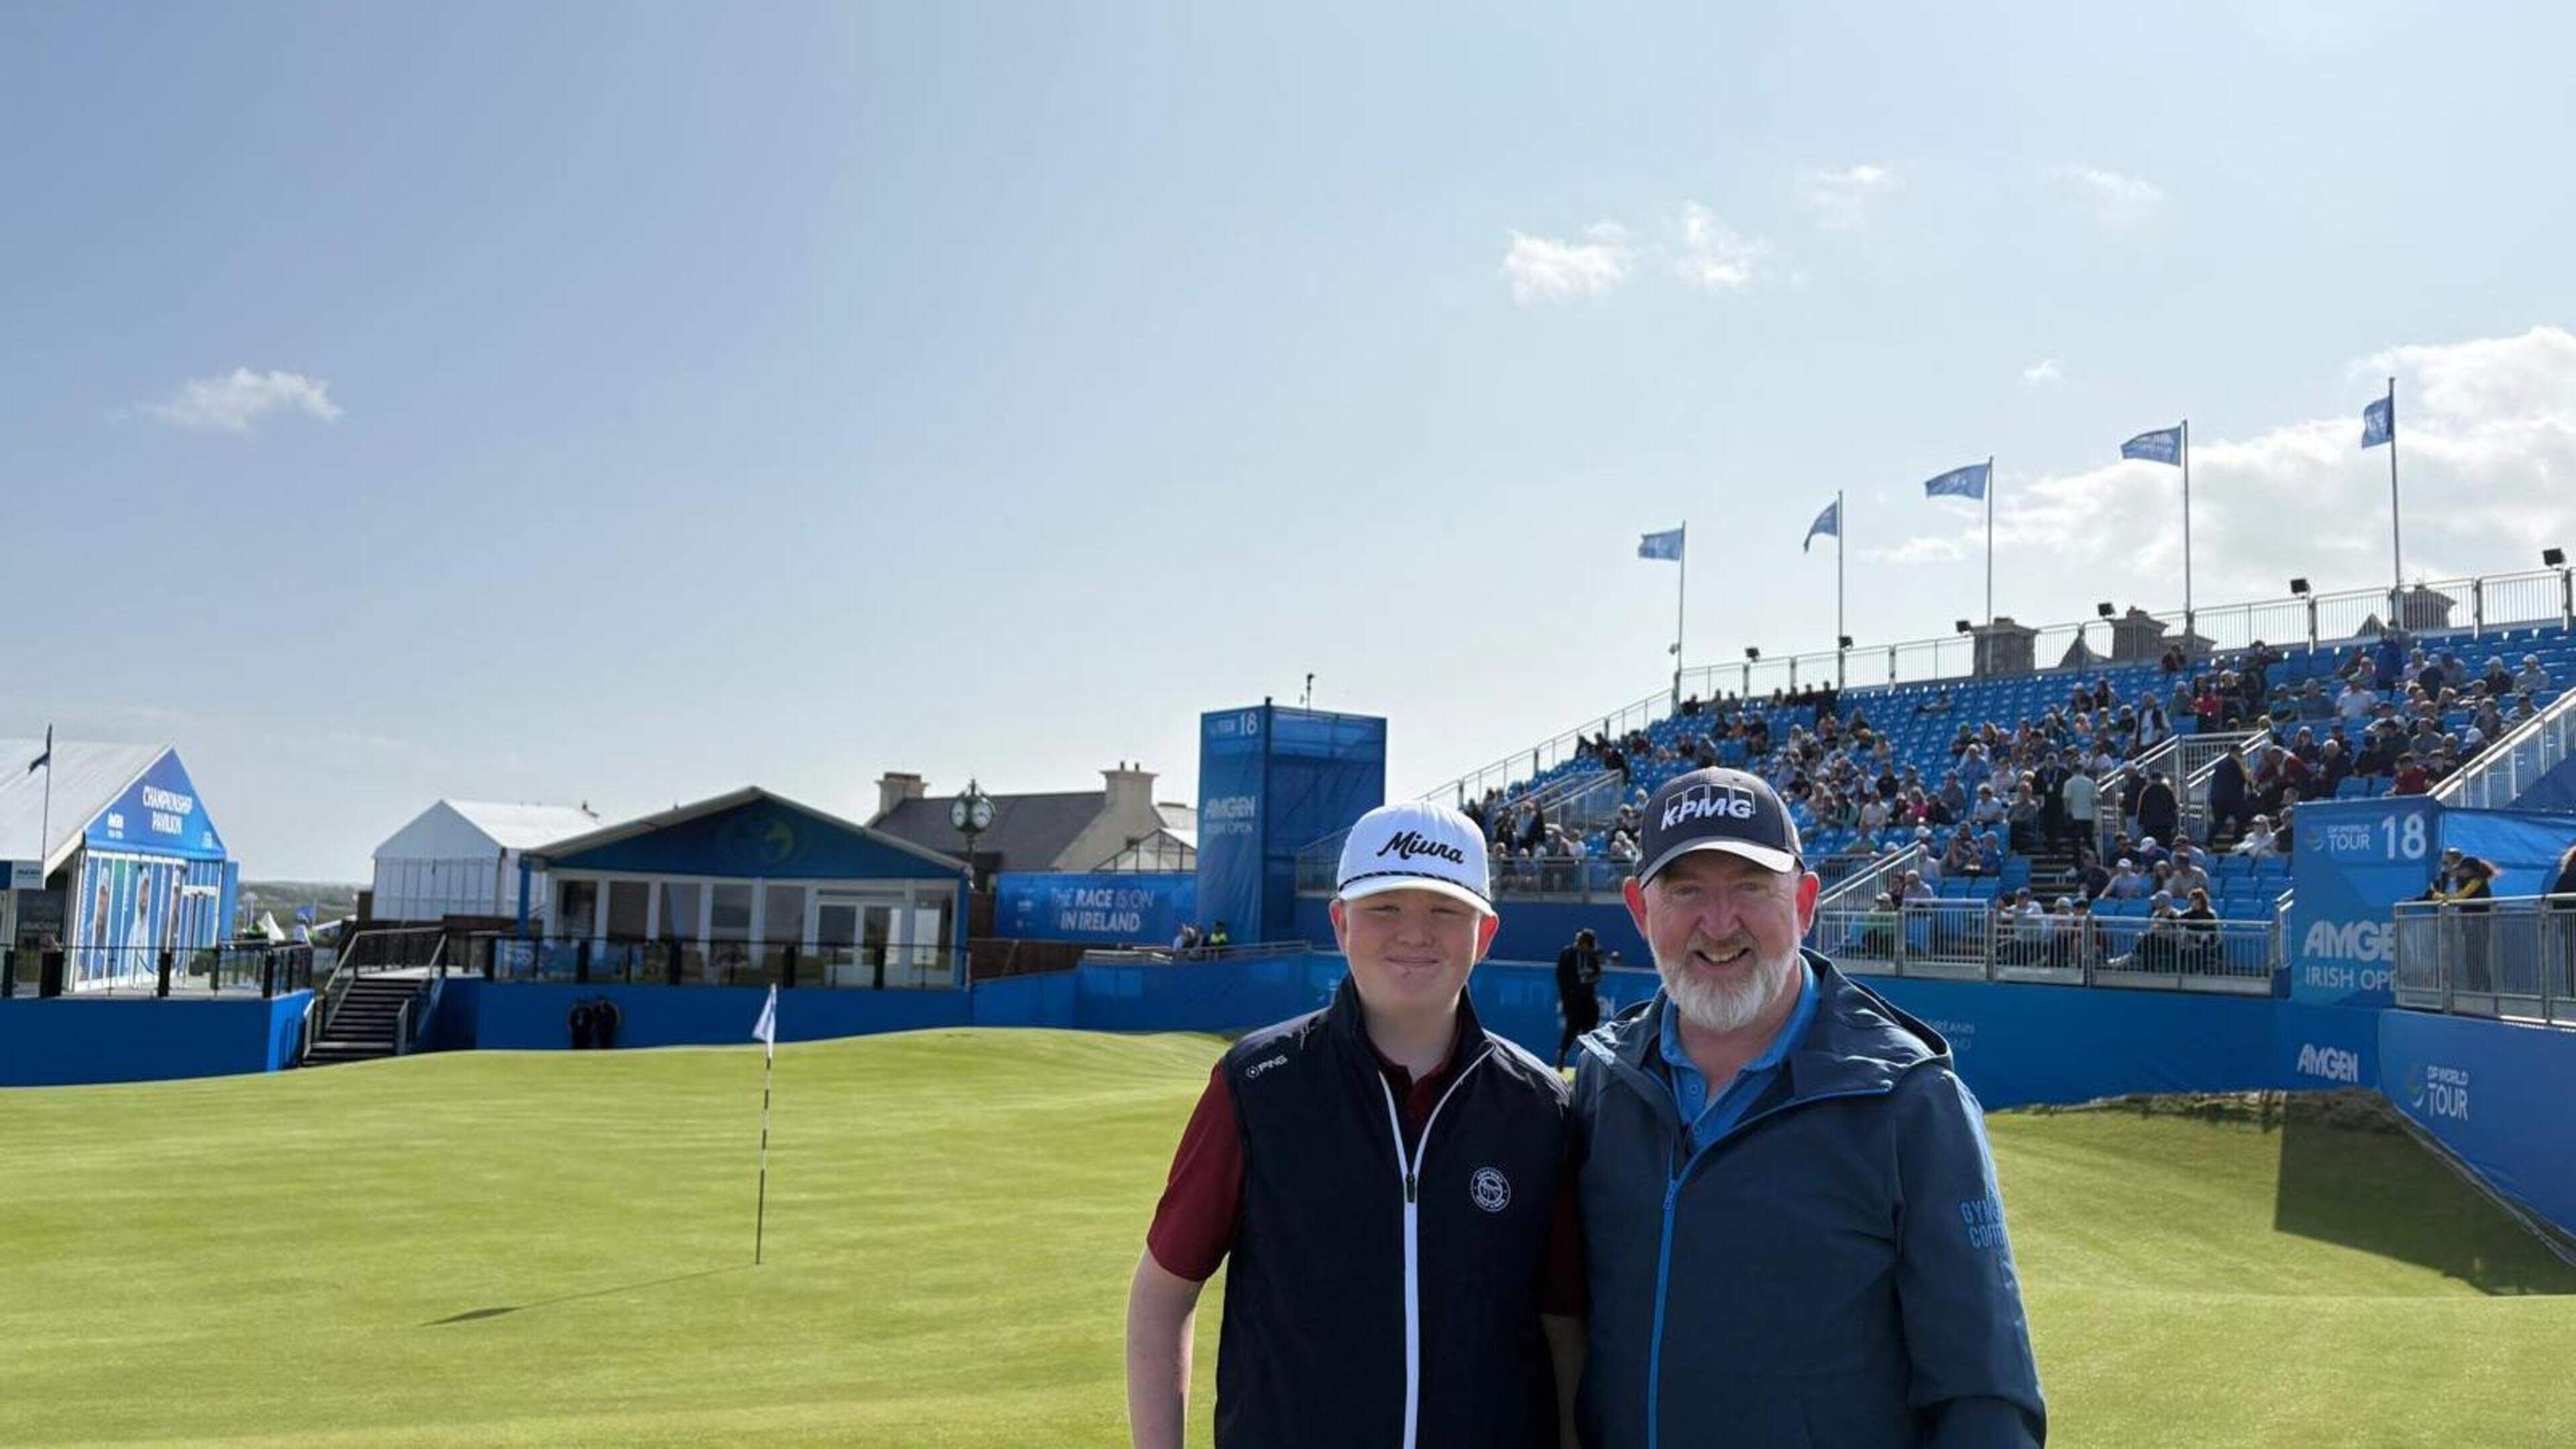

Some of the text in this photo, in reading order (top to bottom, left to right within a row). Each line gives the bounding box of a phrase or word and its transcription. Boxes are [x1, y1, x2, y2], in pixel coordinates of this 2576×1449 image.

[1239, 712, 1258, 737] 18
[143, 785, 193, 815] CHAMPIONSHIP
[1203, 795, 1256, 820] AMGEN
[152, 811, 182, 835] PAVILION
[1661, 798, 1752, 831] KPMG
[1377, 831, 1464, 864] Miura
[2328, 833, 2371, 852] TOUR
[2383, 813, 2427, 859] 18
[1075, 889, 1114, 907] RACE
[1061, 912, 1141, 932] IN IRELAND
[2302, 920, 2396, 961] AMGE
[2306, 966, 2354, 988] IRISH
[1258, 1055, 1288, 1073] PING
[2296, 1043, 2358, 1082] AMGEN
[2427, 1083, 2468, 1121] TOUR
